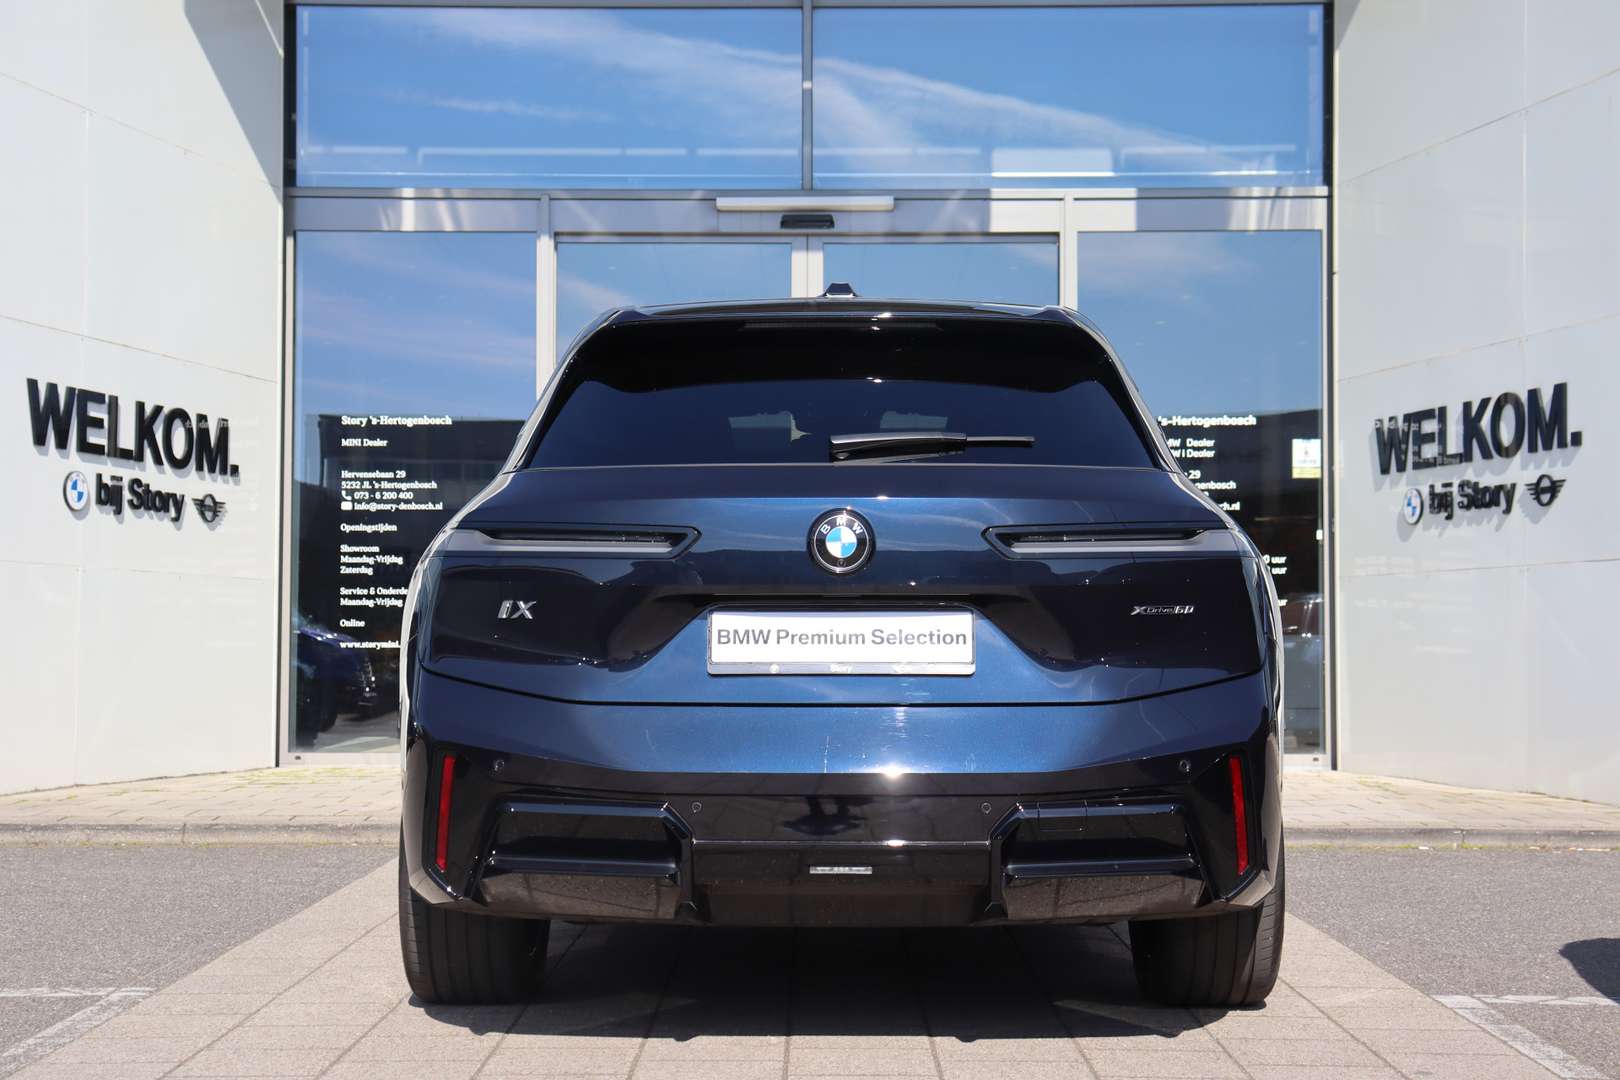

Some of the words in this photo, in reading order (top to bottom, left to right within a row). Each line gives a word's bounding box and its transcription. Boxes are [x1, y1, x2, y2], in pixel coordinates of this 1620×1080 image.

[341, 415, 368, 427] Story
[26, 377, 240, 478] WELKOM.
[1375, 382, 1583, 475] WELKOM.
[341, 438, 362, 447] MINI
[363, 438, 388, 447] Dealer
[1186, 438, 1215, 447] Dealer
[1186, 449, 1215, 458] Dealer
[396, 470, 406, 479] 29
[1188, 469, 1201, 480] 29
[341, 481, 361, 489] 5232
[127, 477, 185, 522] Story
[354, 491, 369, 500] 073
[375, 491, 381, 500] 6
[382, 491, 398, 500] 200
[398, 491, 414, 500] 400
[1457, 479, 1518, 515] Story
[340, 523, 398, 533] Openingstijden
[820, 516, 863, 535] BMW
[340, 544, 379, 553] Showroom
[340, 566, 373, 576] Zaterdag
[340, 587, 369, 595] Service
[369, 587, 376, 595] &
[340, 619, 366, 628] Online
[716, 628, 771, 646] BMW
[776, 629, 866, 646] Premium
[871, 629, 967, 646] Selection
